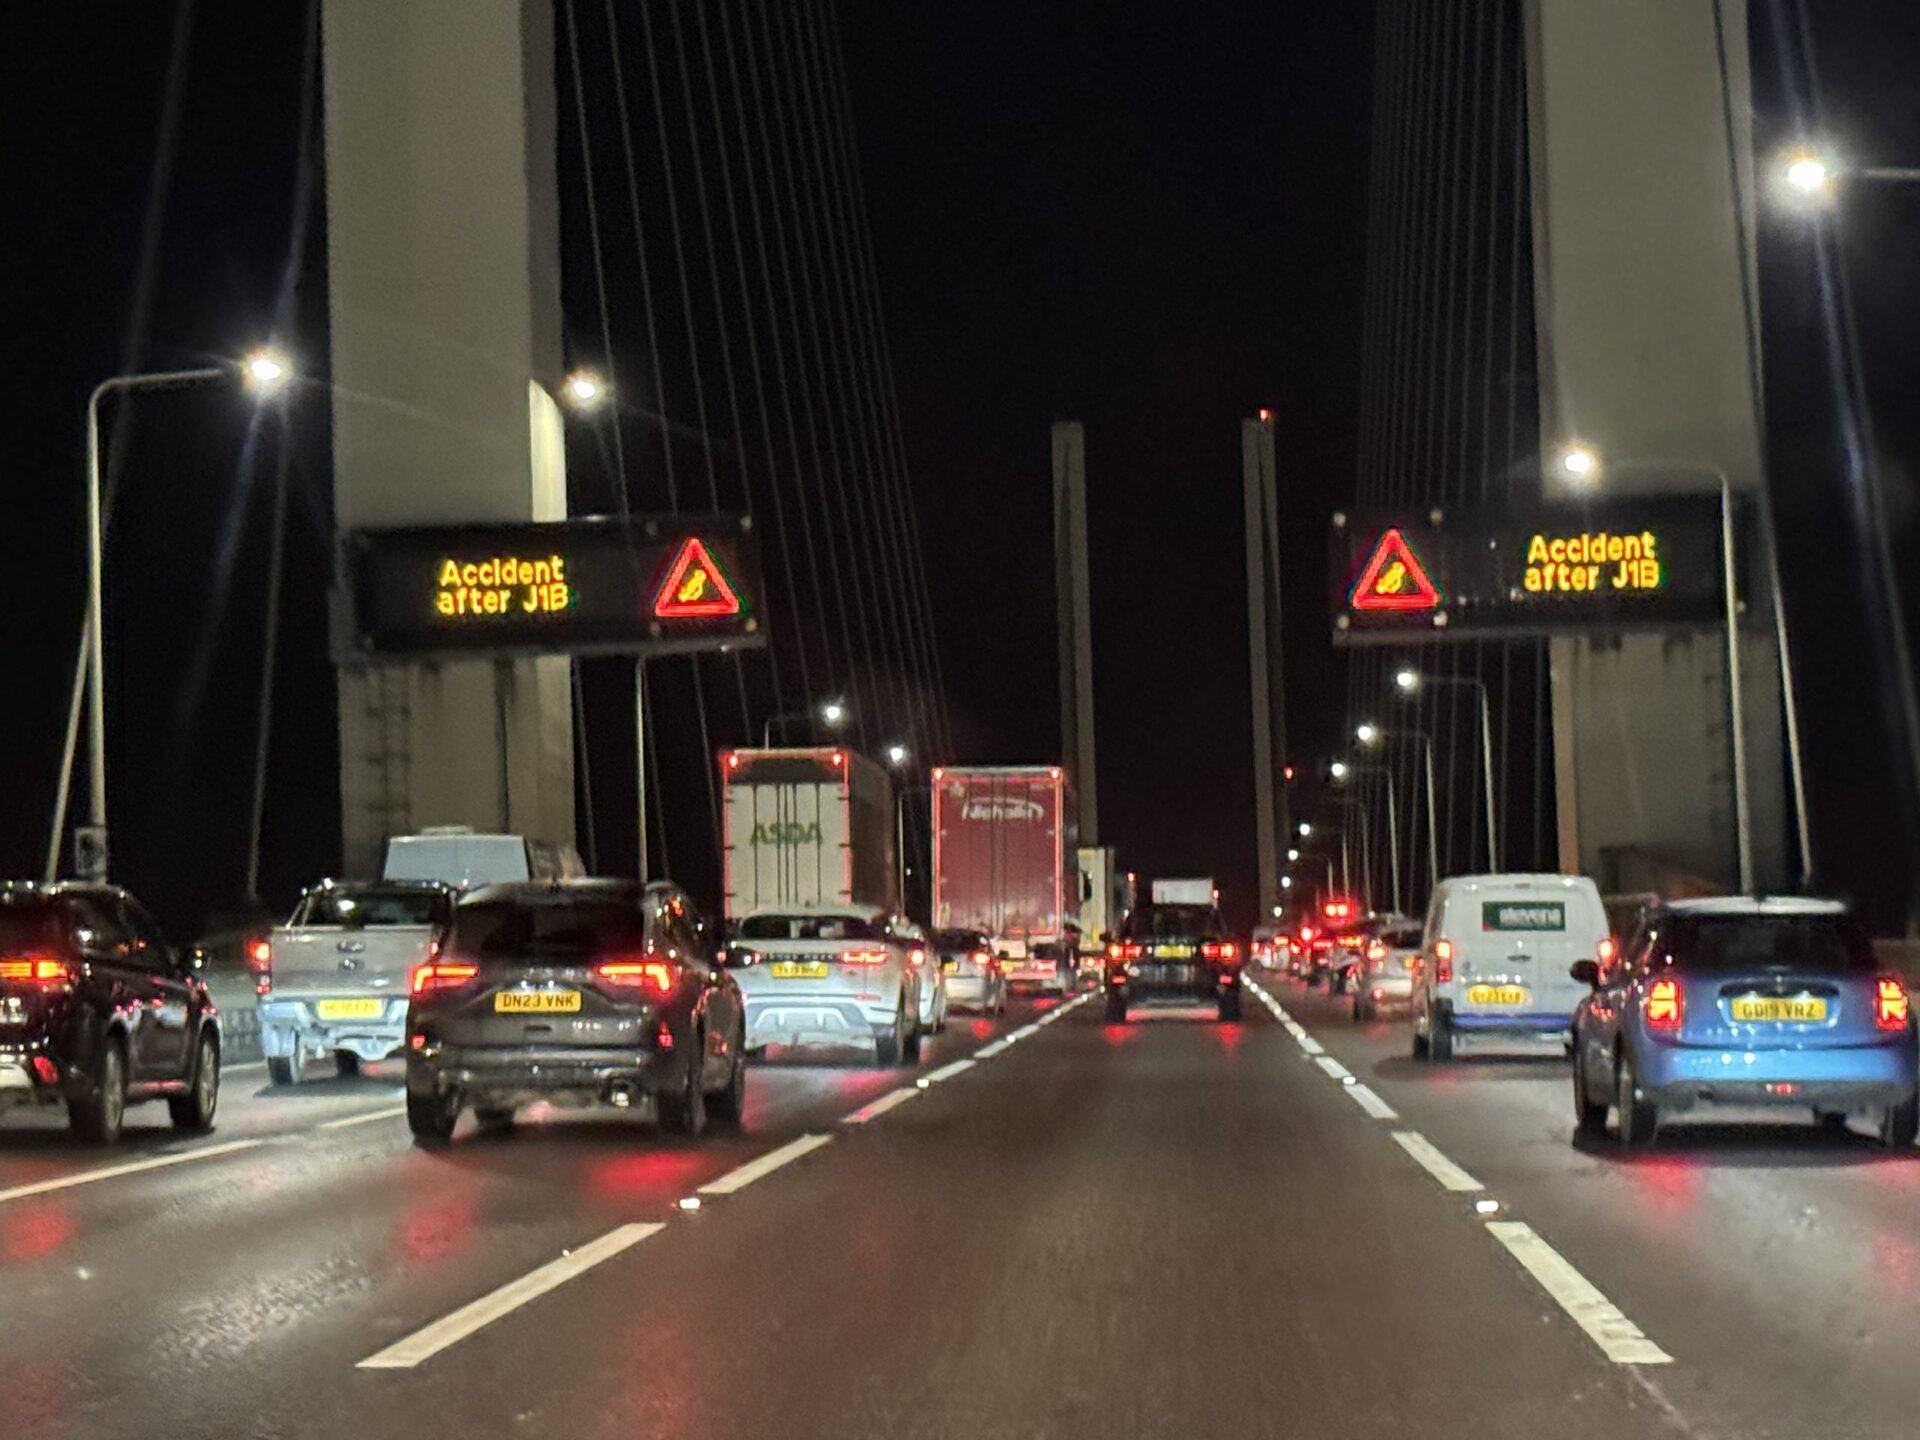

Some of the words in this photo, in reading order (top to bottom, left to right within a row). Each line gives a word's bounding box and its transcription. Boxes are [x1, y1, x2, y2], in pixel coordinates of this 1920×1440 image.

[1528, 532, 1656, 563] Accident
[440, 555, 565, 586] Accident
[1524, 564, 1599, 591] after
[1612, 558, 1660, 590] J1B
[436, 586, 512, 616] after
[522, 581, 570, 613] J1B
[750, 821, 824, 846] ASDA
